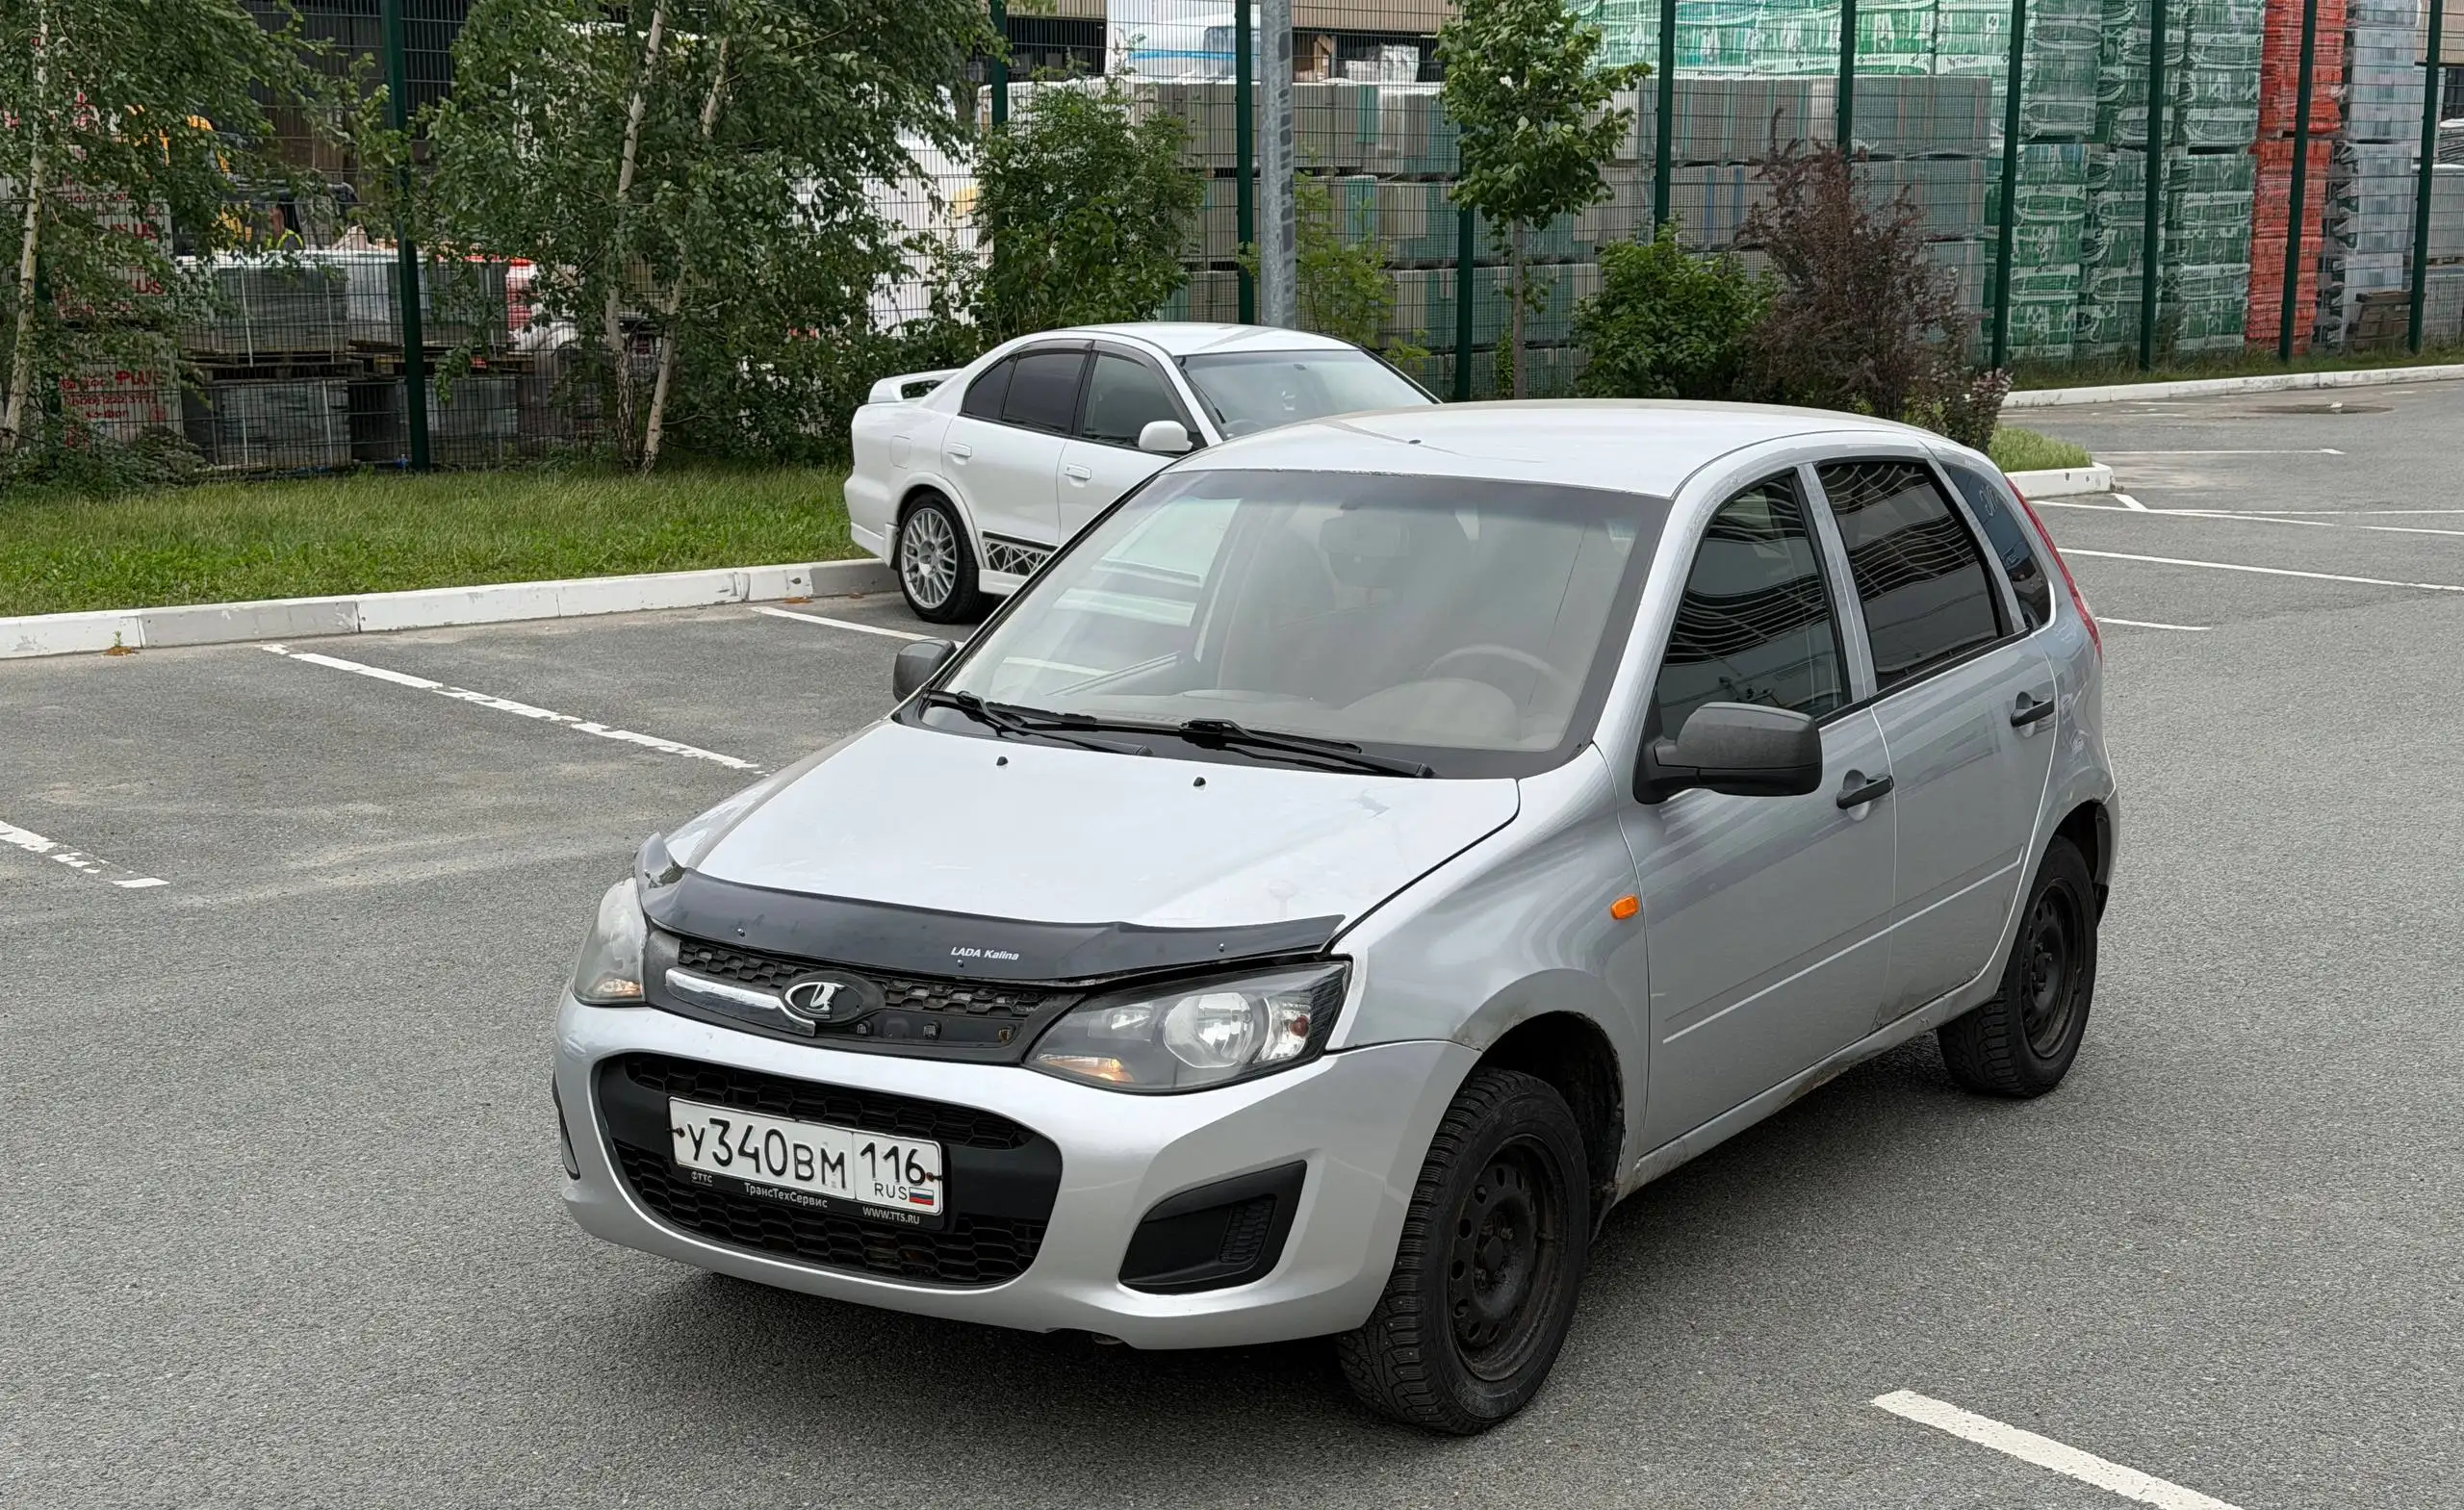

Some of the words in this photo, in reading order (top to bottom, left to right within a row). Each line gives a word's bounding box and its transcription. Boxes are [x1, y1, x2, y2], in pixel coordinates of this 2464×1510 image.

[951, 946, 981, 958] LADA
[984, 949, 1019, 960] Kalina
[860, 1141, 926, 1186] 116
[744, 1183, 828, 1208] ТрансТехСервис
[874, 1183, 908, 1200] RUS
[862, 1205, 920, 1225] WWW.TTS.RU
